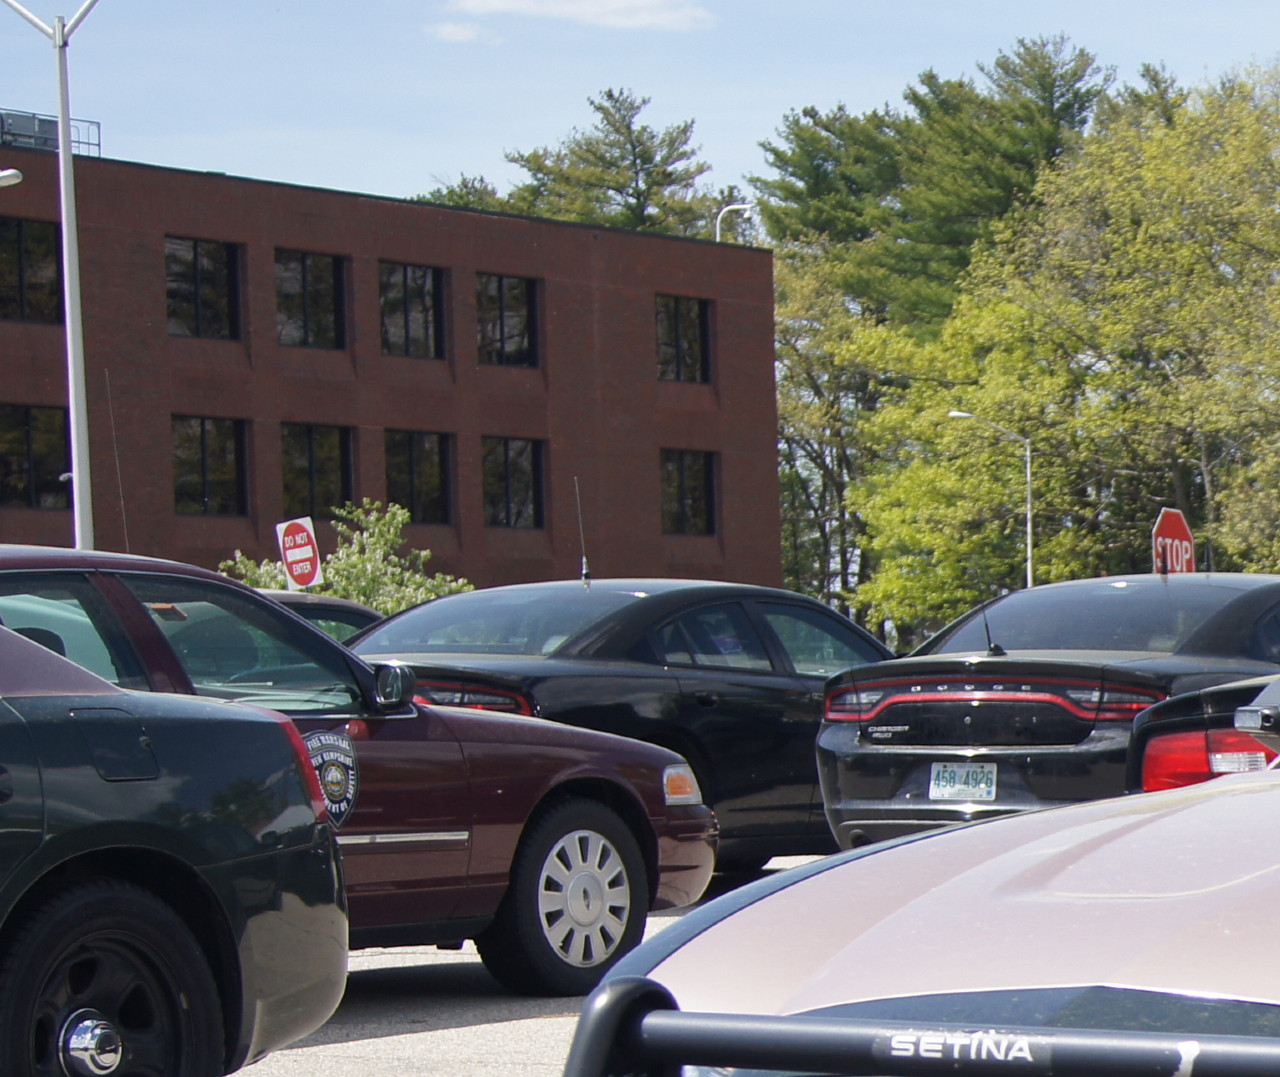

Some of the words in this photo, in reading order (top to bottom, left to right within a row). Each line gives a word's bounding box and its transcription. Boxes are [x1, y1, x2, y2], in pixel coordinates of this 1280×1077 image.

[284, 535, 294, 548] DO
[295, 532, 308, 545] NOT
[1156, 536, 1191, 572] STOP
[292, 561, 312, 575] ENTER
[933, 769, 956, 788] 458
[891, 1035, 1034, 1062] SETINA
